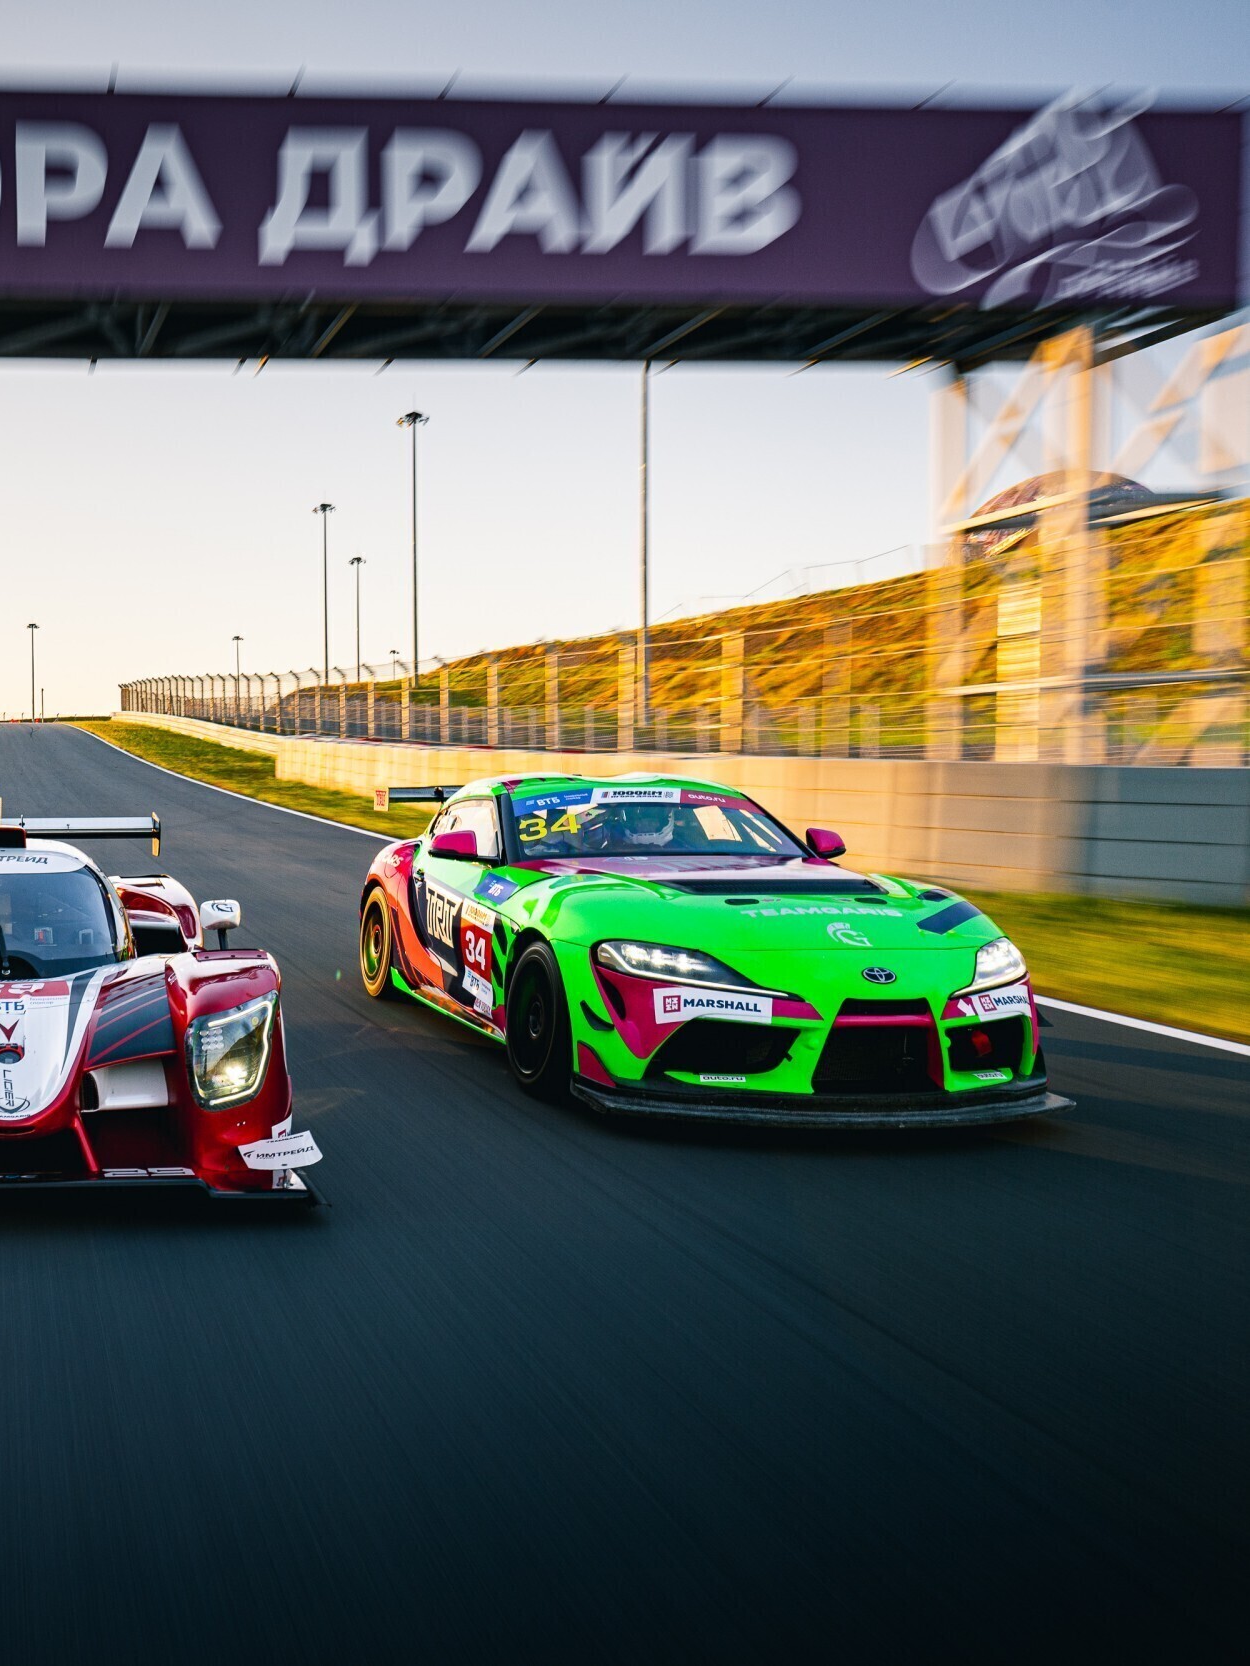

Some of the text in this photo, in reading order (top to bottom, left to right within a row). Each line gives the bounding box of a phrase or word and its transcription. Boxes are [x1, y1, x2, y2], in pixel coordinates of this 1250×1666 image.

[258, 125, 802, 268] ДРАЙВ
[536, 796, 561, 806] ВТБ
[688, 793, 726, 803] auto.ru
[519, 813, 582, 842] 34
[740, 906, 903, 918] TEAMGARIS
[465, 930, 486, 971] 34
[683, 998, 762, 1013] MARSHALL
[3, 1069, 15, 1107] LIGIER
[102, 1166, 196, 1178] 29
